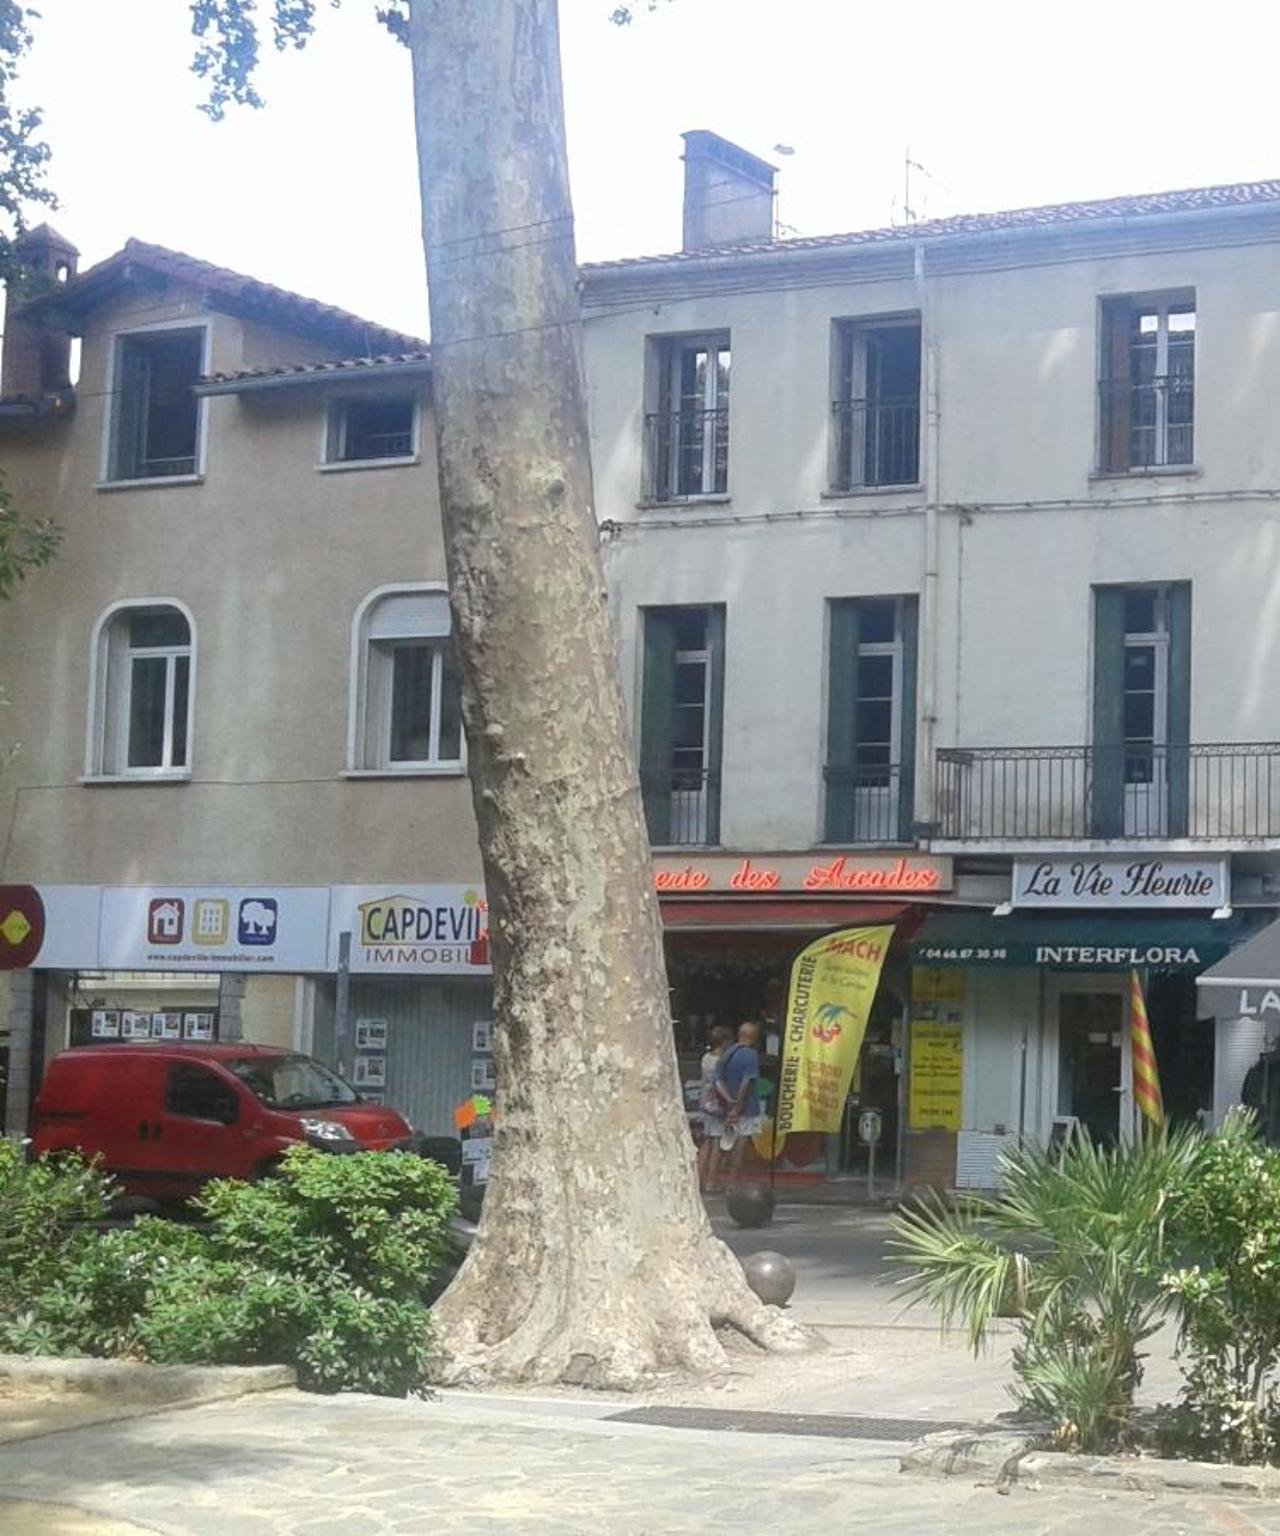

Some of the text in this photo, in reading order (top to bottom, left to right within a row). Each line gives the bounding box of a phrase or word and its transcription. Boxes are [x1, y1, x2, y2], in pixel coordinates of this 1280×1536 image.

[655, 855, 940, 889] erie des Arcades
[1023, 860, 1214, 897] La Vie Fleurie
[1035, 946, 1201, 964] INTERFLORA
[779, 955, 818, 1131] BOUCHERIE CHARCUTERIE
